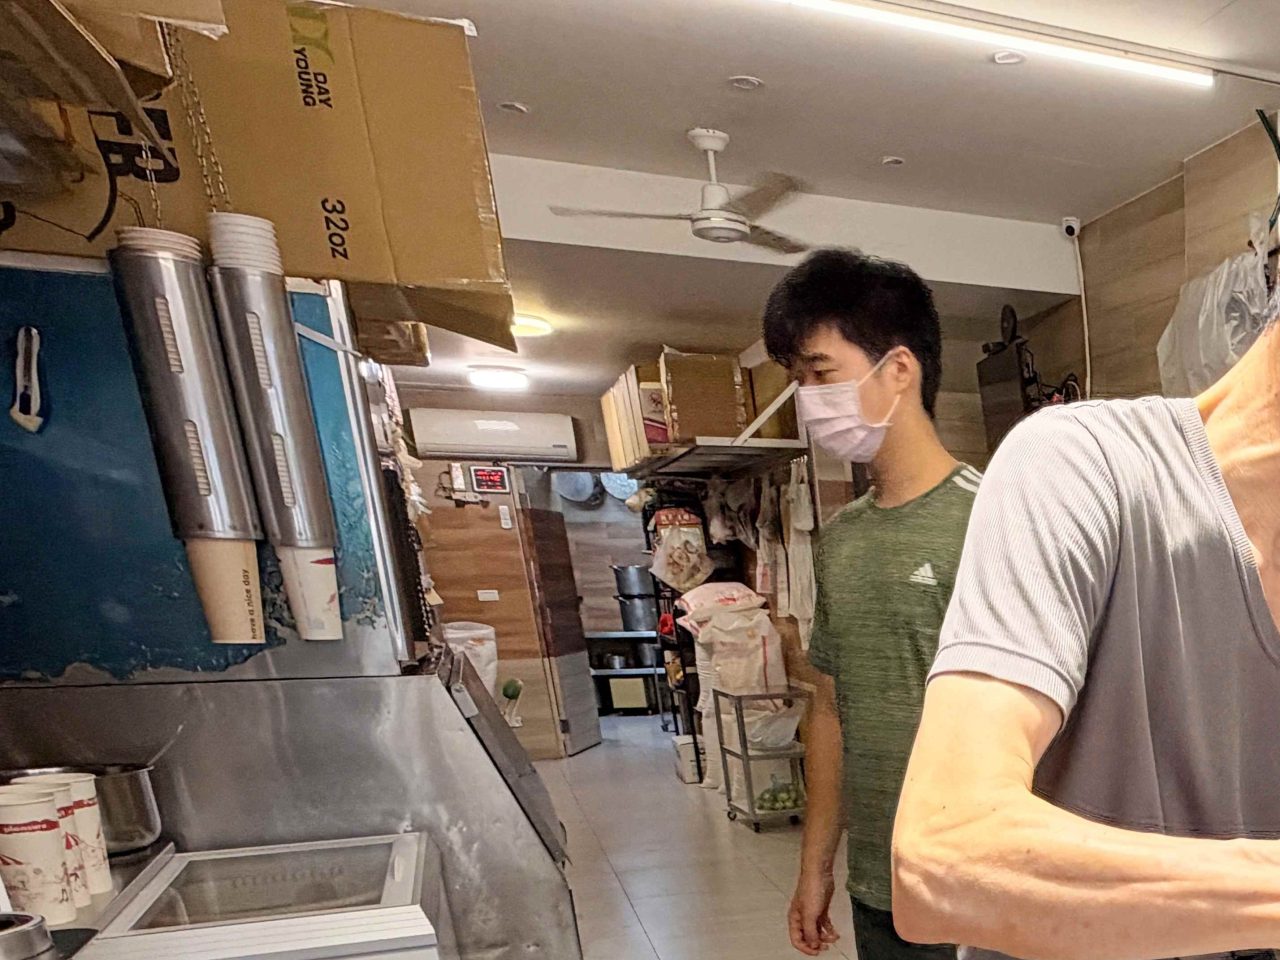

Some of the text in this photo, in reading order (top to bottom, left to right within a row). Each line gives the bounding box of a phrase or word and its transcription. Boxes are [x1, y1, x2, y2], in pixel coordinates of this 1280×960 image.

[293, 47, 317, 107] YOUNG
[313, 71, 333, 109] DAY
[242, 569, 250, 586] day
